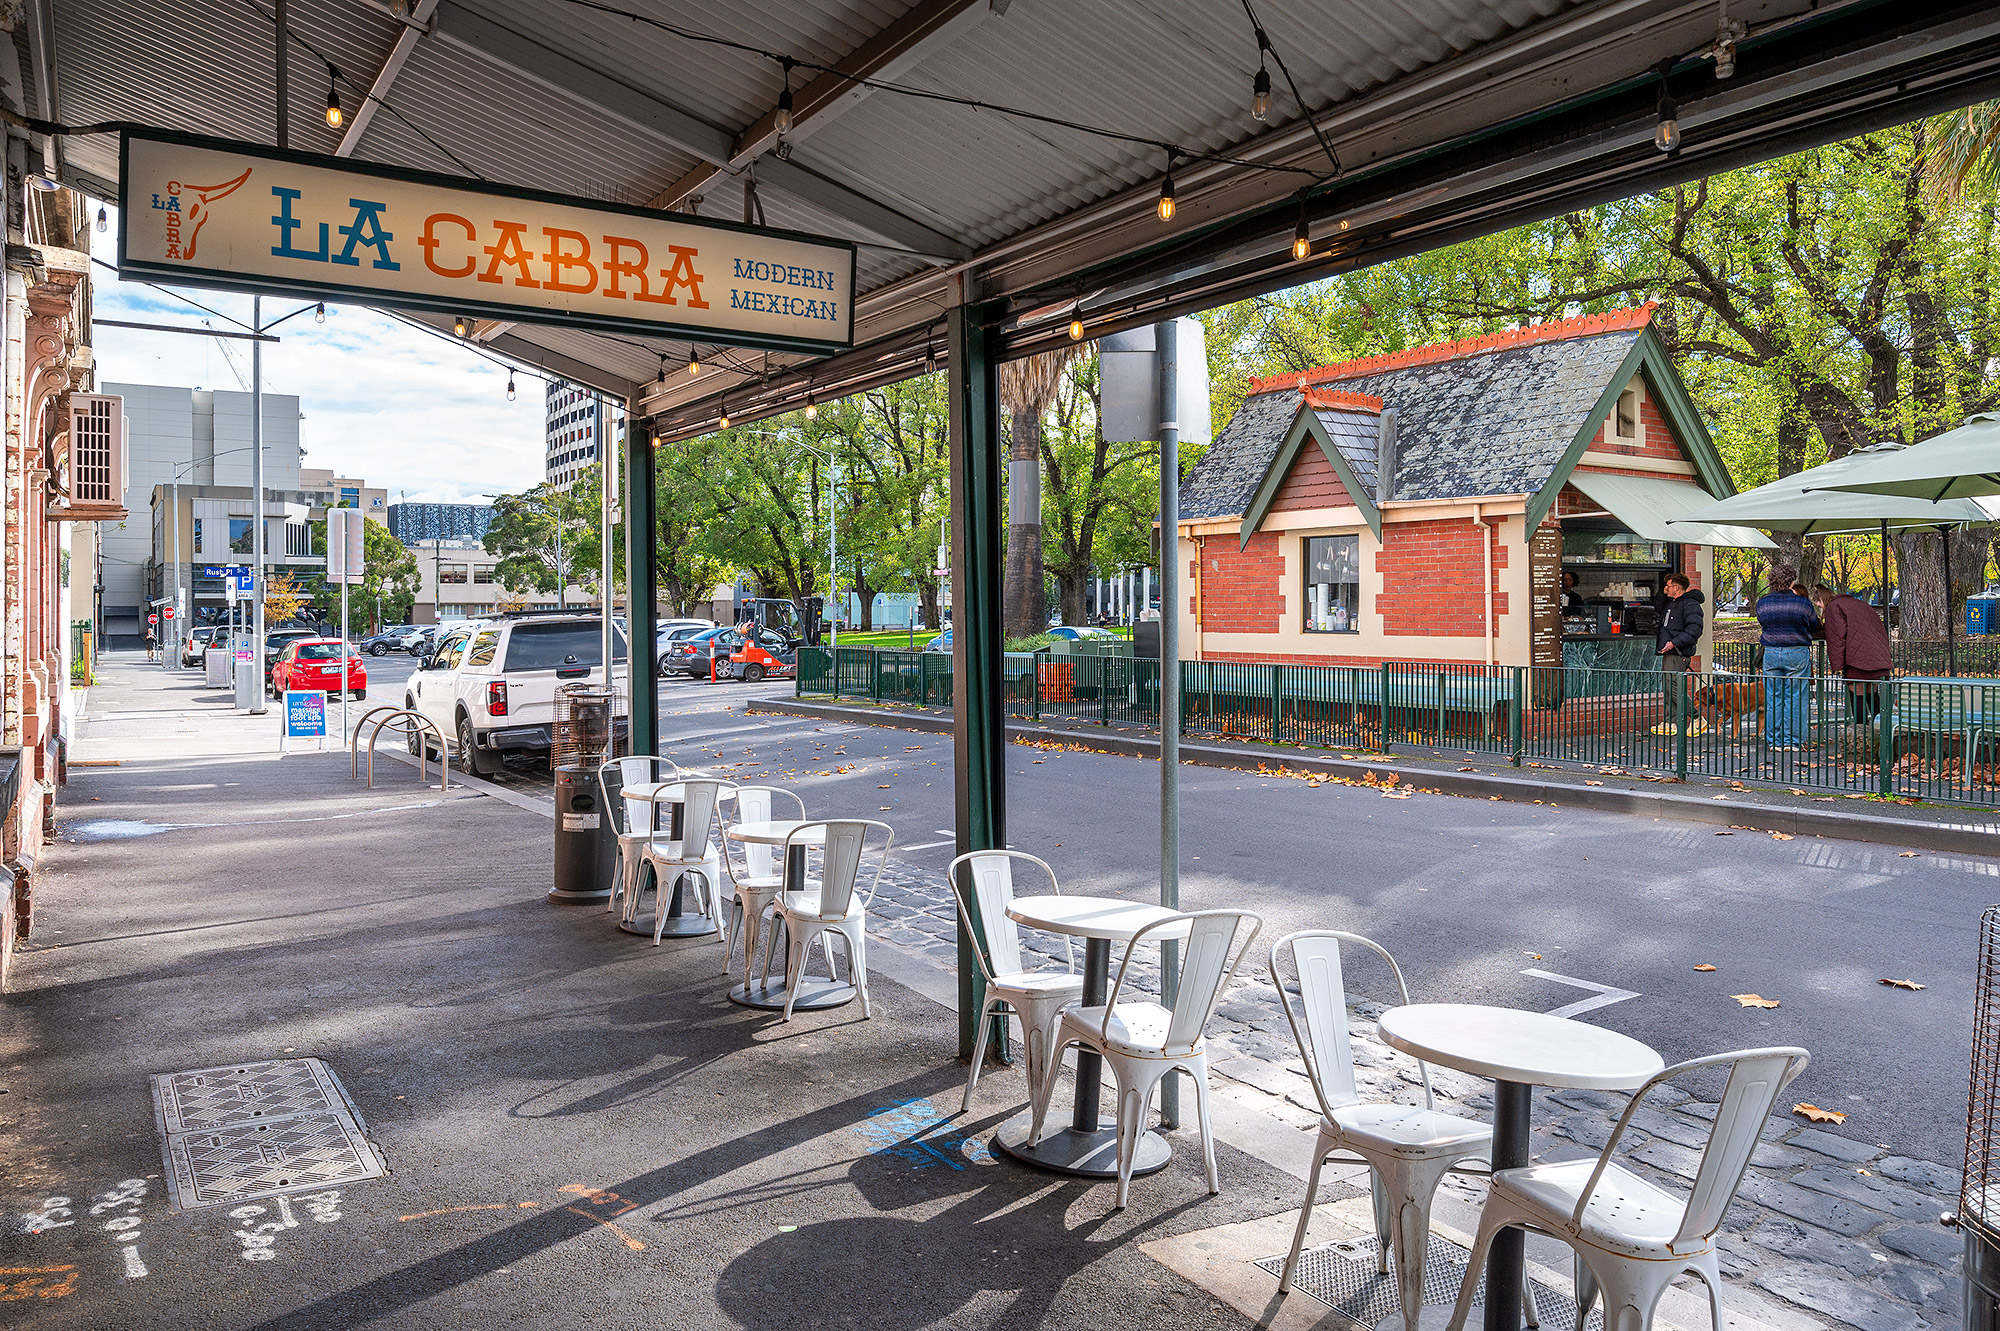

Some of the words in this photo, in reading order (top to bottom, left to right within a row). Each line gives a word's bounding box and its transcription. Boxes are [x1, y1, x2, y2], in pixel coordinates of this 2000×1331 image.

[271, 186, 401, 272] LA
[418, 212, 710, 310] CABRA
[733, 258, 834, 291] MODERN
[730, 289, 837, 321] MEXICAN
